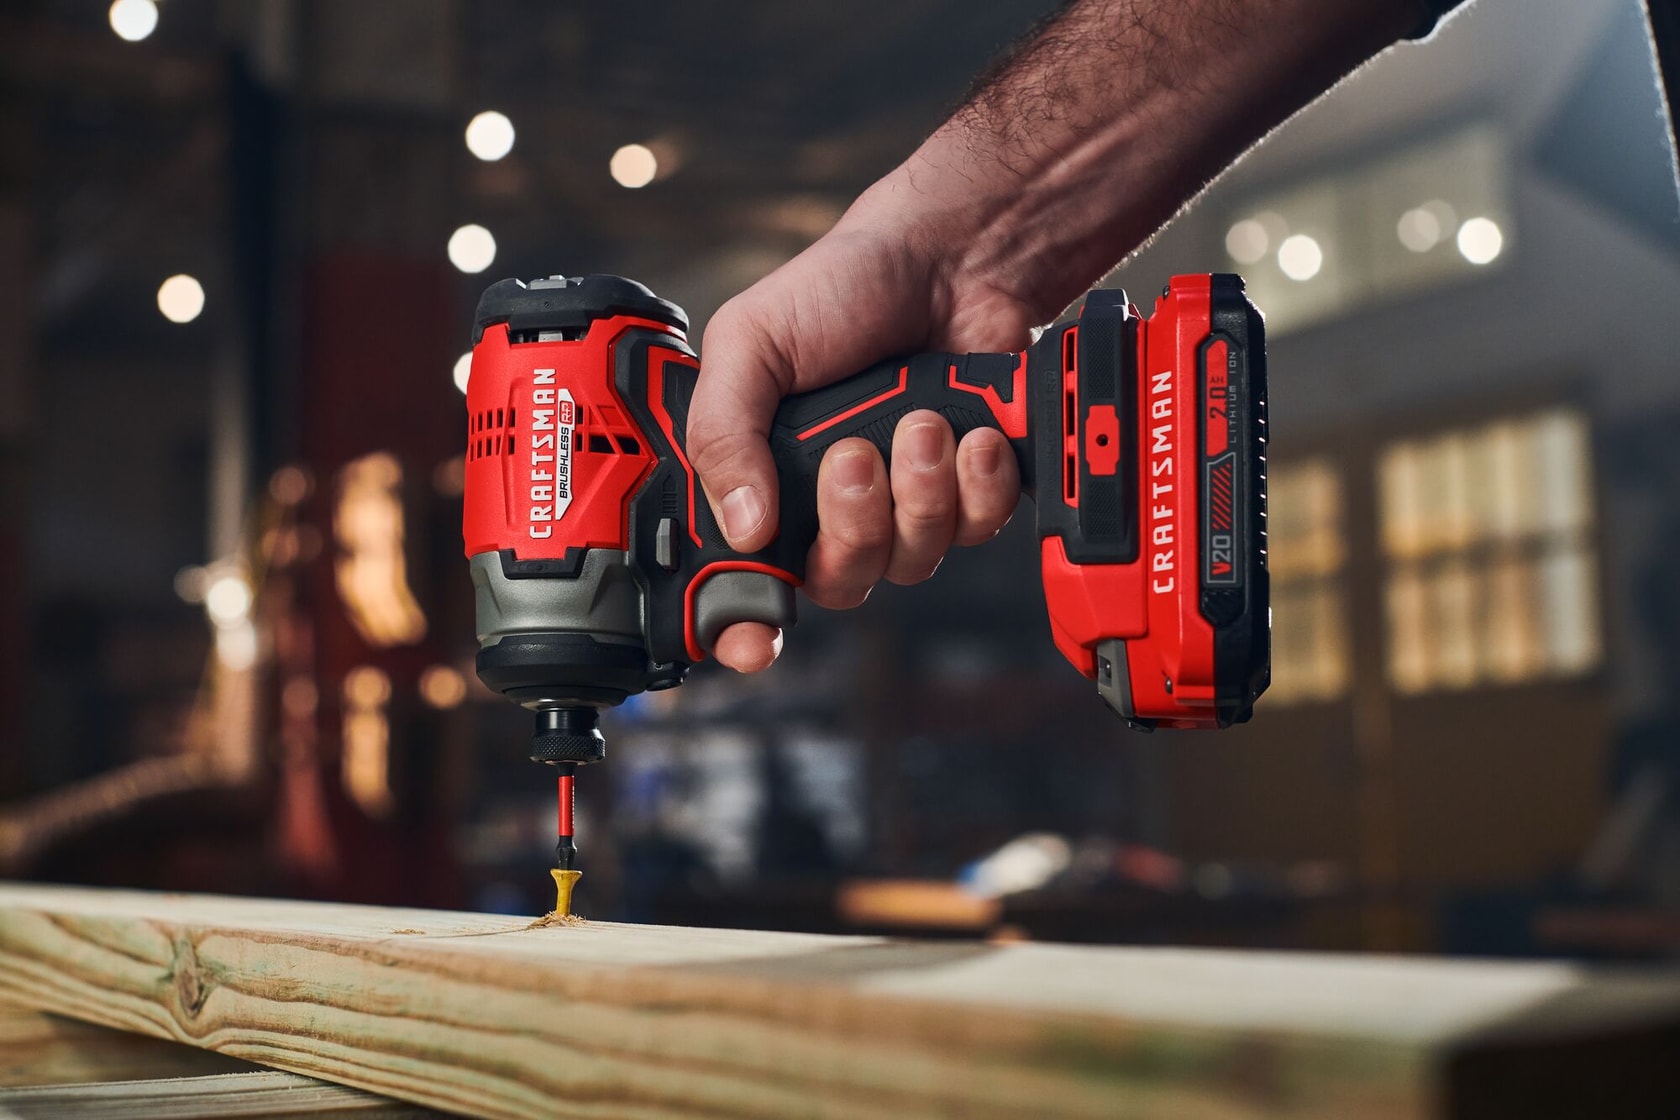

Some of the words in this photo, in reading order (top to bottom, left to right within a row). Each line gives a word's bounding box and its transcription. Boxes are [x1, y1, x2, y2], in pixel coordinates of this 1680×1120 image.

[1228, 351, 1237, 373] ION
[1209, 387, 1227, 419] 2.0
[1228, 385, 1237, 444] LITHIUM
[529, 368, 556, 539] CRAFTSMAN
[559, 426, 569, 499] BRUSHLESS
[1152, 370, 1175, 594] CRAFTSMAN
[1211, 535, 1232, 576] V20
